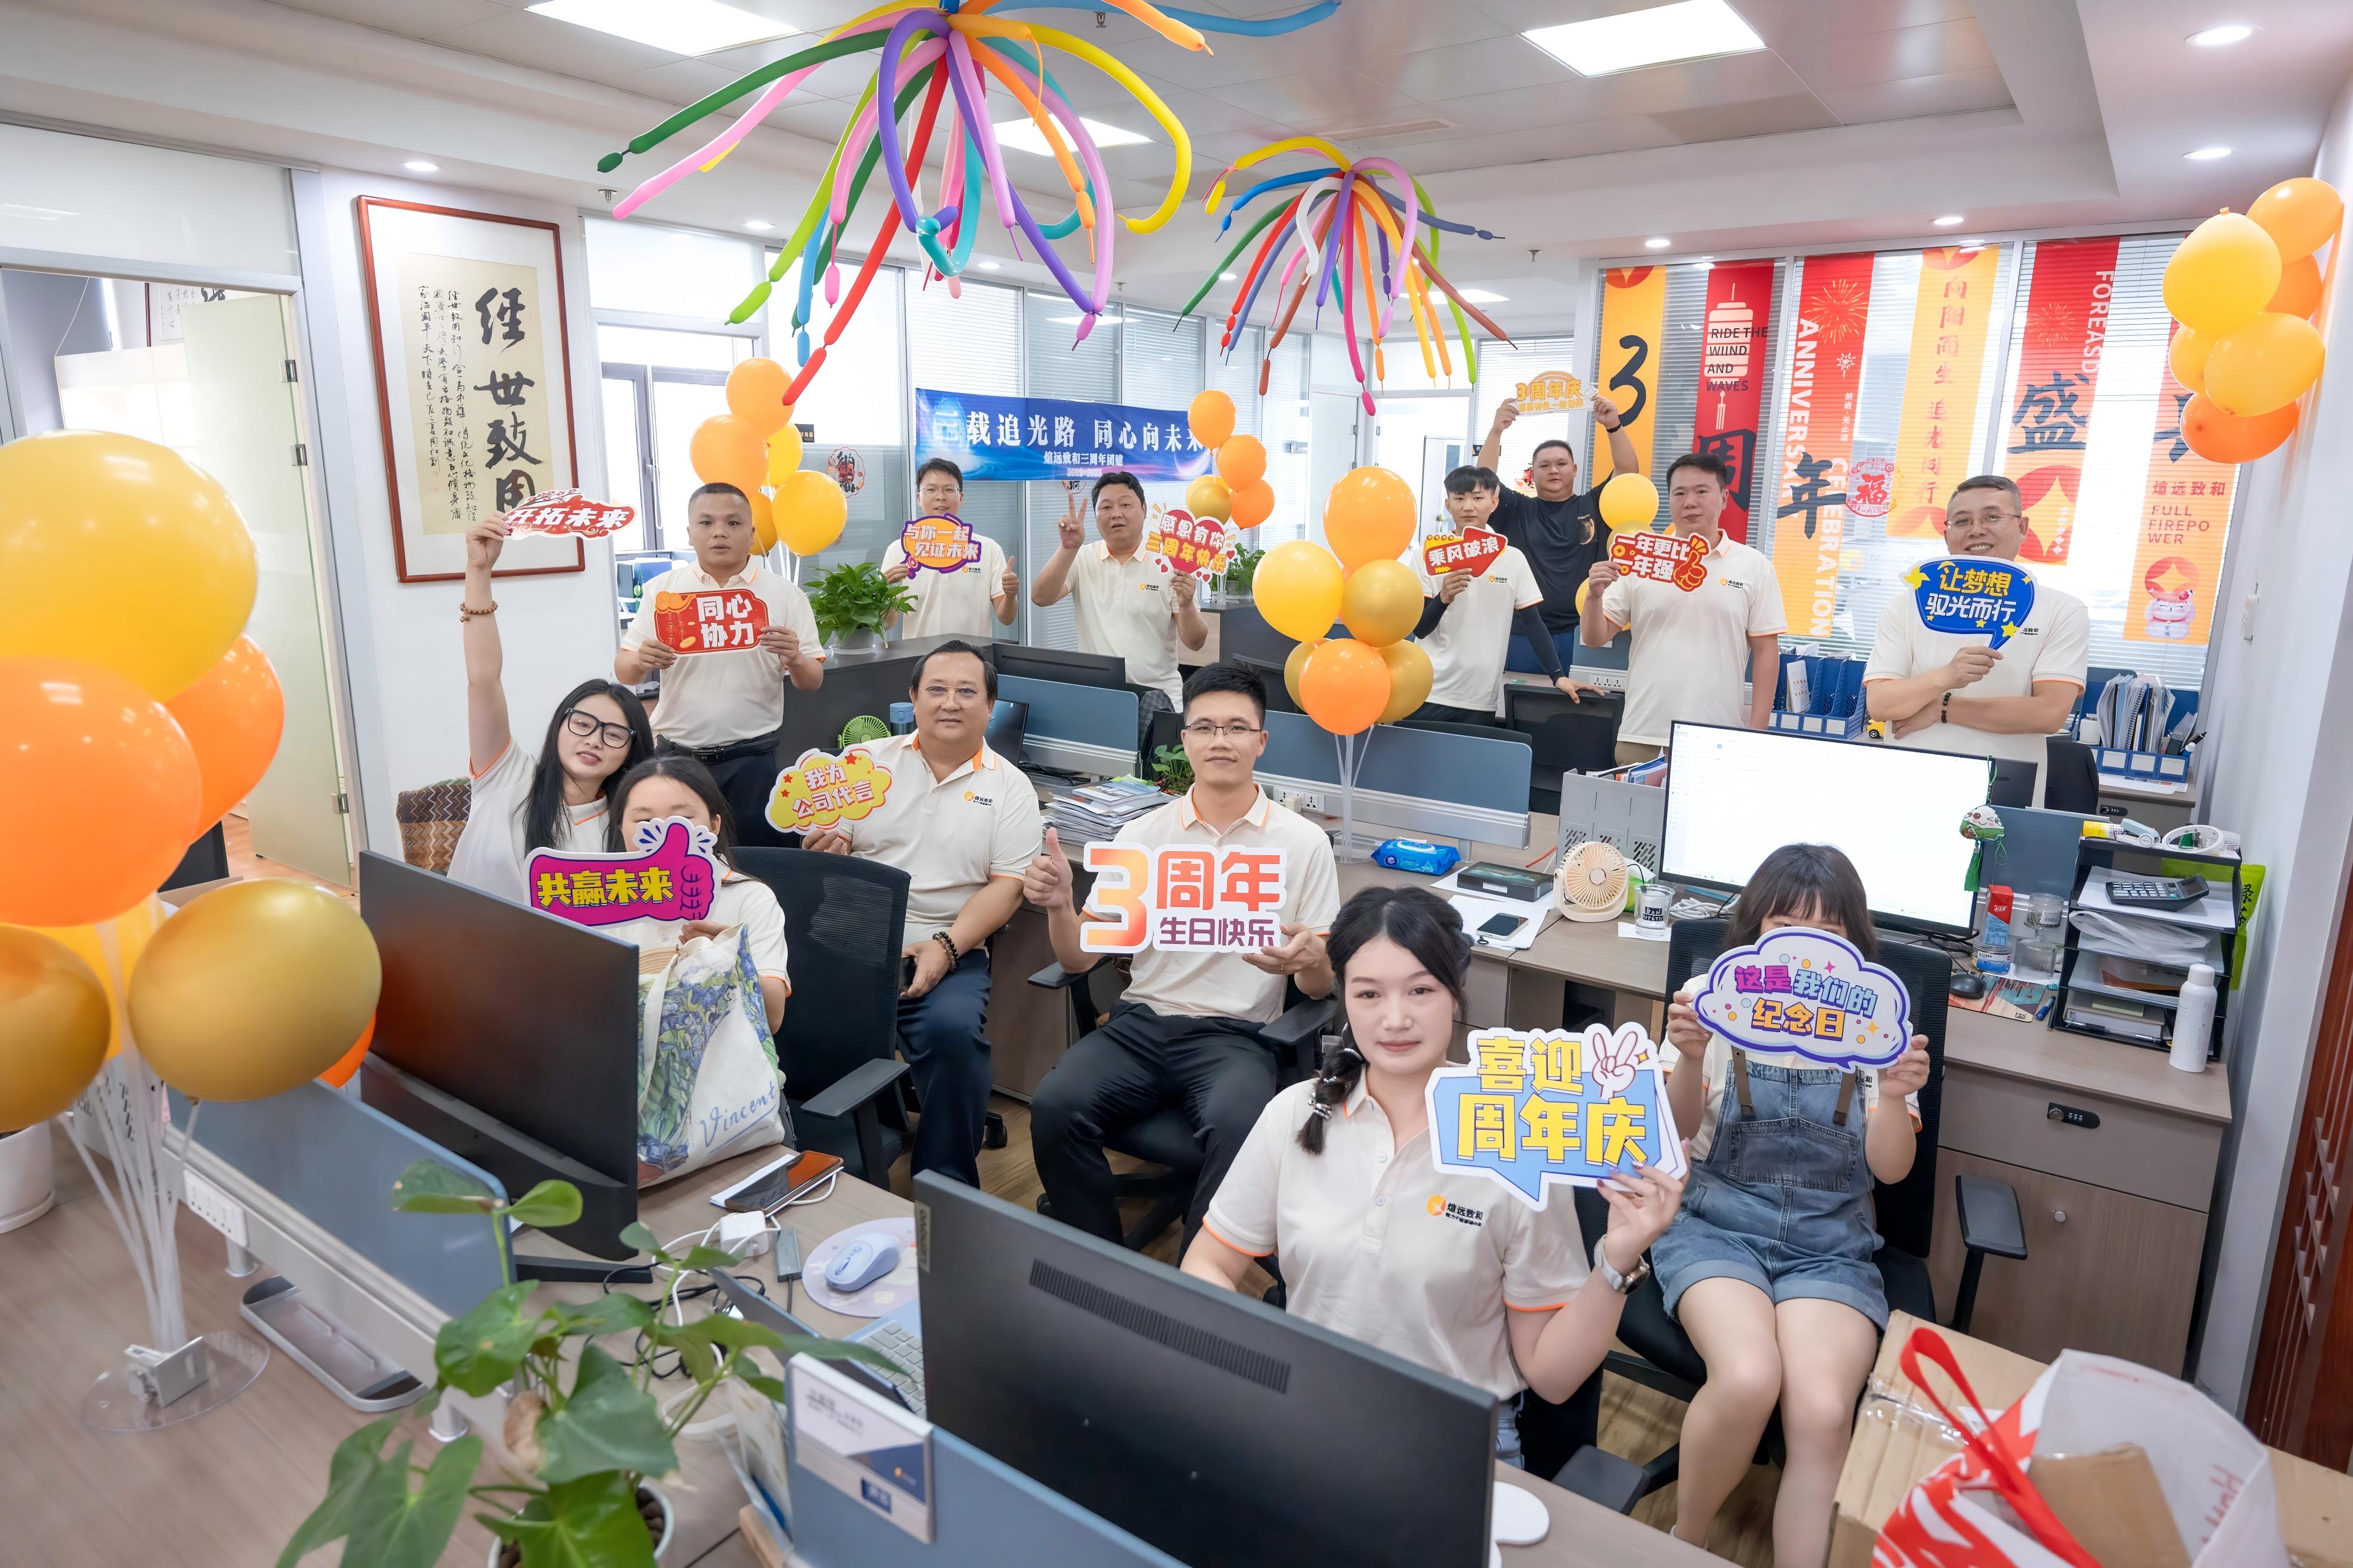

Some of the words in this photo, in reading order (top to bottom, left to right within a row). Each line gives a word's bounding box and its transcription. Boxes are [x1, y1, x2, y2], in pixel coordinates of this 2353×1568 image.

[1711, 328, 1740, 339] RIDE
[1744, 327, 1768, 338] THE
[1934, 275, 1967, 385] 向阳而生
[1709, 346, 1747, 356] WIIND
[1609, 335, 1648, 428] 3
[1707, 363, 1734, 374] AND
[1516, 379, 1582, 401] 3周年庆
[1707, 381, 1749, 391] WAVES
[2007, 371, 2089, 453] 盛
[935, 411, 1076, 447] 三载追光路
[1094, 419, 1204, 452] 同心向未来
[1918, 398, 1948, 504] 追光同行
[1777, 452, 1847, 540] 年
[1855, 473, 1888, 505] 福
[508, 506, 631, 529] 开拓未来
[2148, 519, 2210, 532] FIREPO
[2152, 505, 2192, 516] FULL
[904, 523, 972, 543] 与你一起
[1159, 513, 1225, 550] 感恩有你
[2148, 533, 2184, 544] WER
[914, 540, 981, 561] 见证未来
[1145, 531, 1228, 574] 三周年快乐
[1428, 536, 1499, 566] 乘风破浪
[1615, 535, 1691, 562] 一年更比
[1611, 555, 1675, 581] 一年强
[1938, 565, 2012, 597] 让梦想
[698, 594, 752, 622] 同心
[1924, 592, 2017, 623] 驭光而行
[701, 622, 755, 648] 协力
[804, 763, 848, 792] 我为
[792, 779, 875, 820] 公司代言
[536, 866, 675, 909] 共赢未来
[1159, 916, 1276, 947] 生日快乐
[1734, 965, 1878, 1019] 这是我们的
[1751, 997, 1846, 1042] 纪念日
[1477, 1036, 1584, 1096] 喜迎
[699, 1080, 777, 1148] Vincent
[1457, 1093, 1648, 1167] 周年庆
